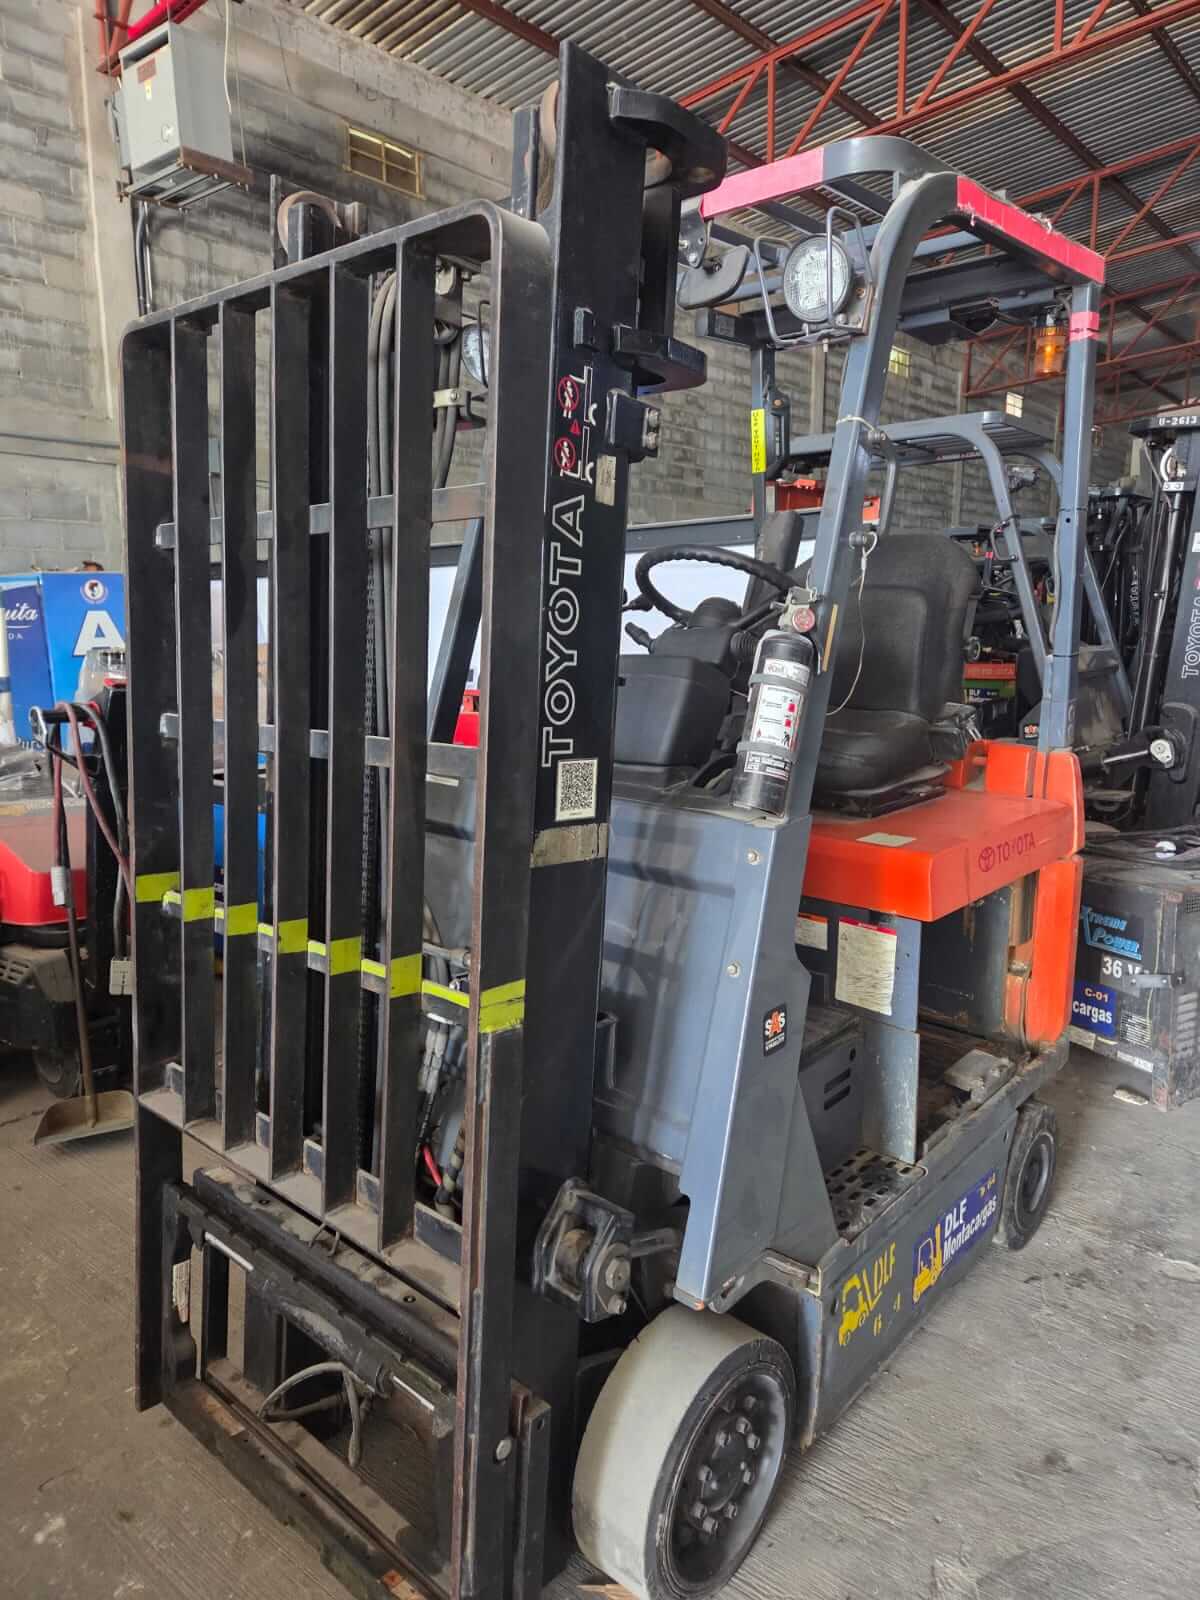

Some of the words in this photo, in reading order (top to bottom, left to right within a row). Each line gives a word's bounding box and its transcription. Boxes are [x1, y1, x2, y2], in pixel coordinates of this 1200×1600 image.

[541, 494, 585, 768] TOYOTA
[996, 831, 1036, 865] TOYOTA
[1102, 956, 1123, 978] 36
[764, 1010, 786, 1038] SAS
[1072, 1000, 1113, 1024] cargas
[943, 1195, 997, 1264] Montacargas
[944, 1198, 967, 1239] DLF
